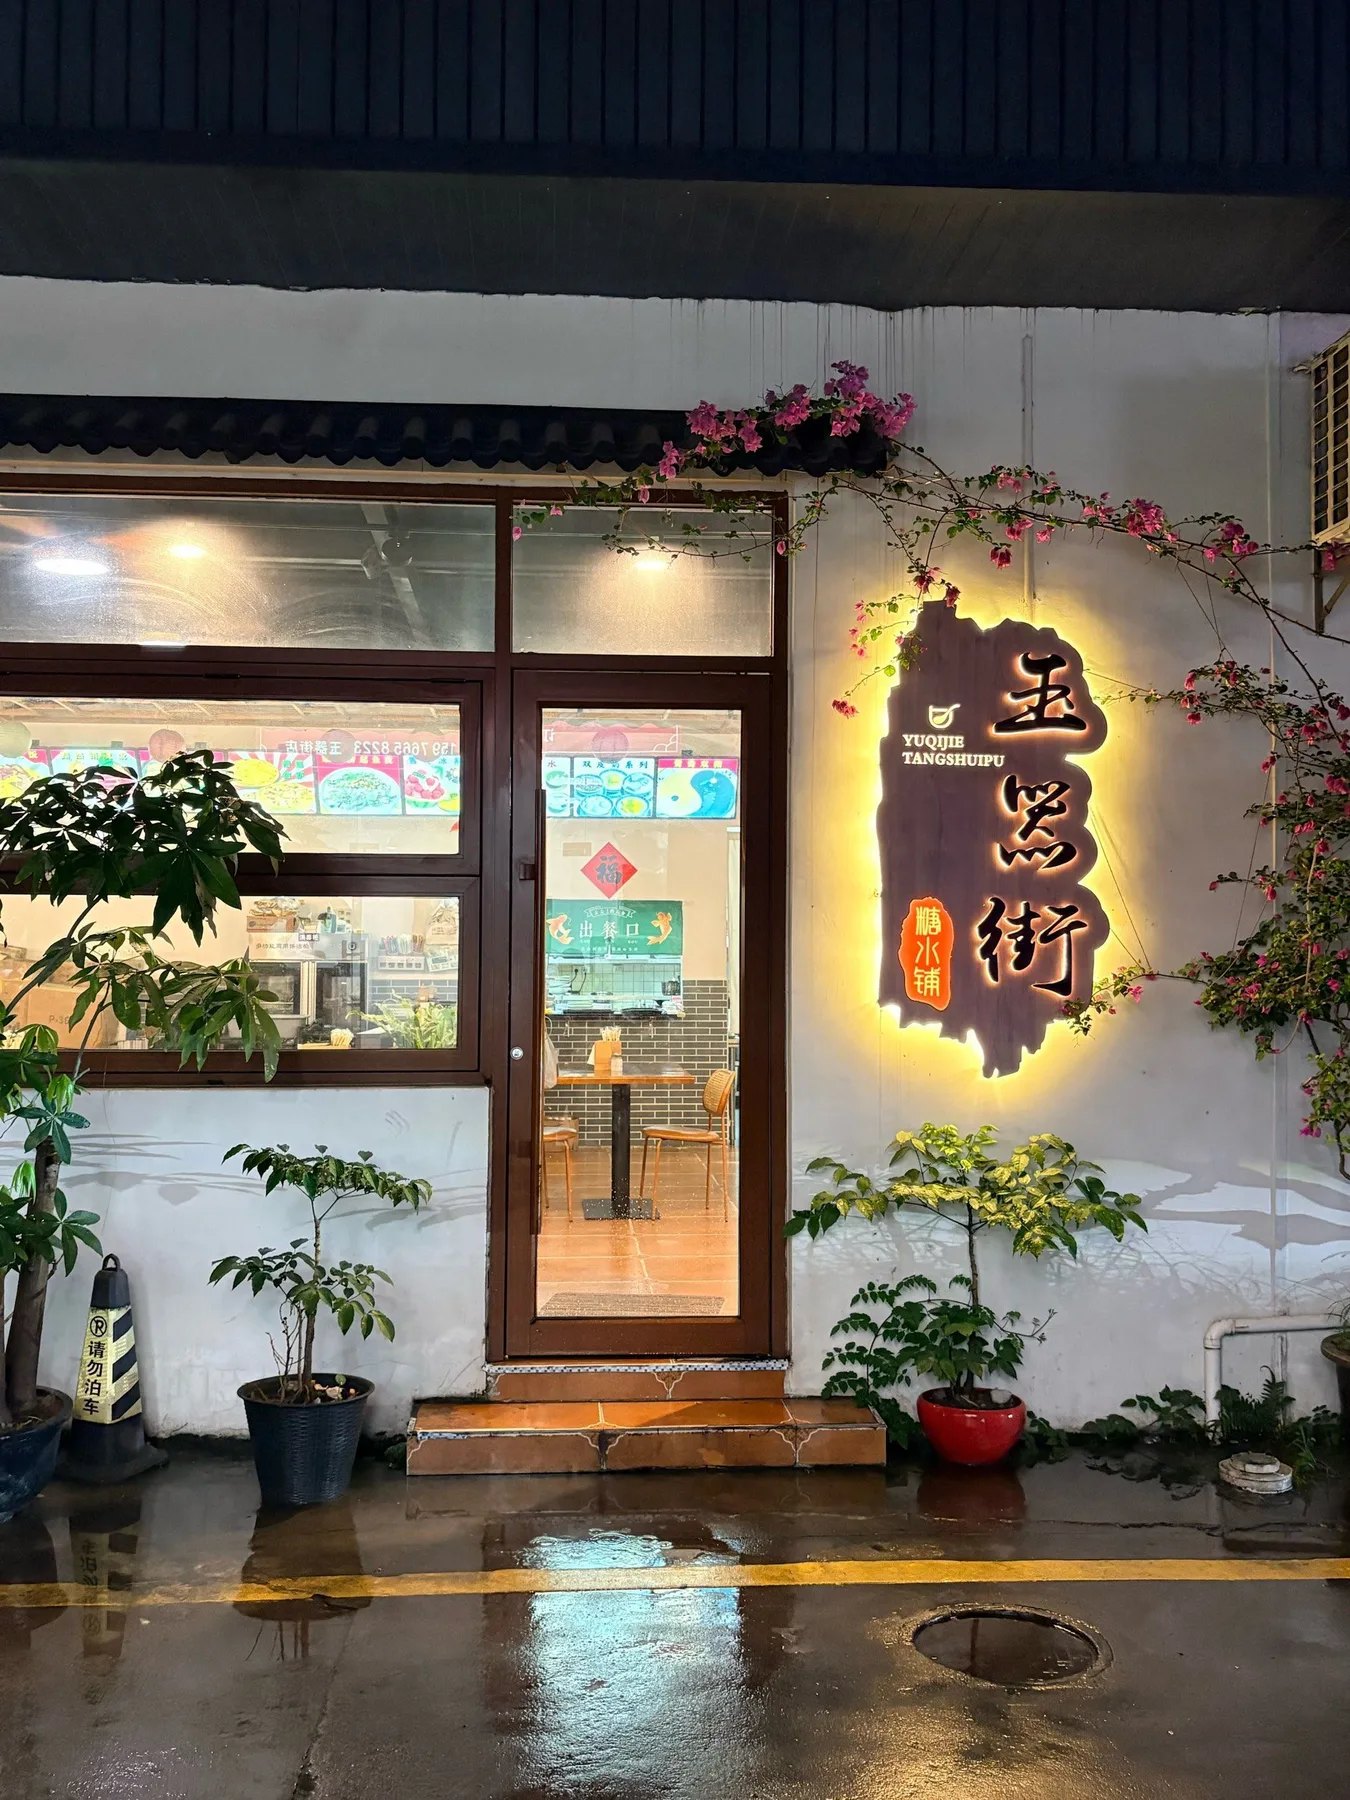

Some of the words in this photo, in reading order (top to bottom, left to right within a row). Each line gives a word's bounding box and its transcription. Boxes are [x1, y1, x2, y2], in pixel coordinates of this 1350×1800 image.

[902, 734, 964, 750] YUQIJIE
[902, 752, 1005, 767] TANGSHUIPU
[976, 652, 1088, 996] 玉器街
[595, 855, 622, 884] 福
[579, 920, 640, 939] 出餐口
[914, 906, 941, 997] 糖水铺
[83, 1340, 106, 1415] 请勿泊车
